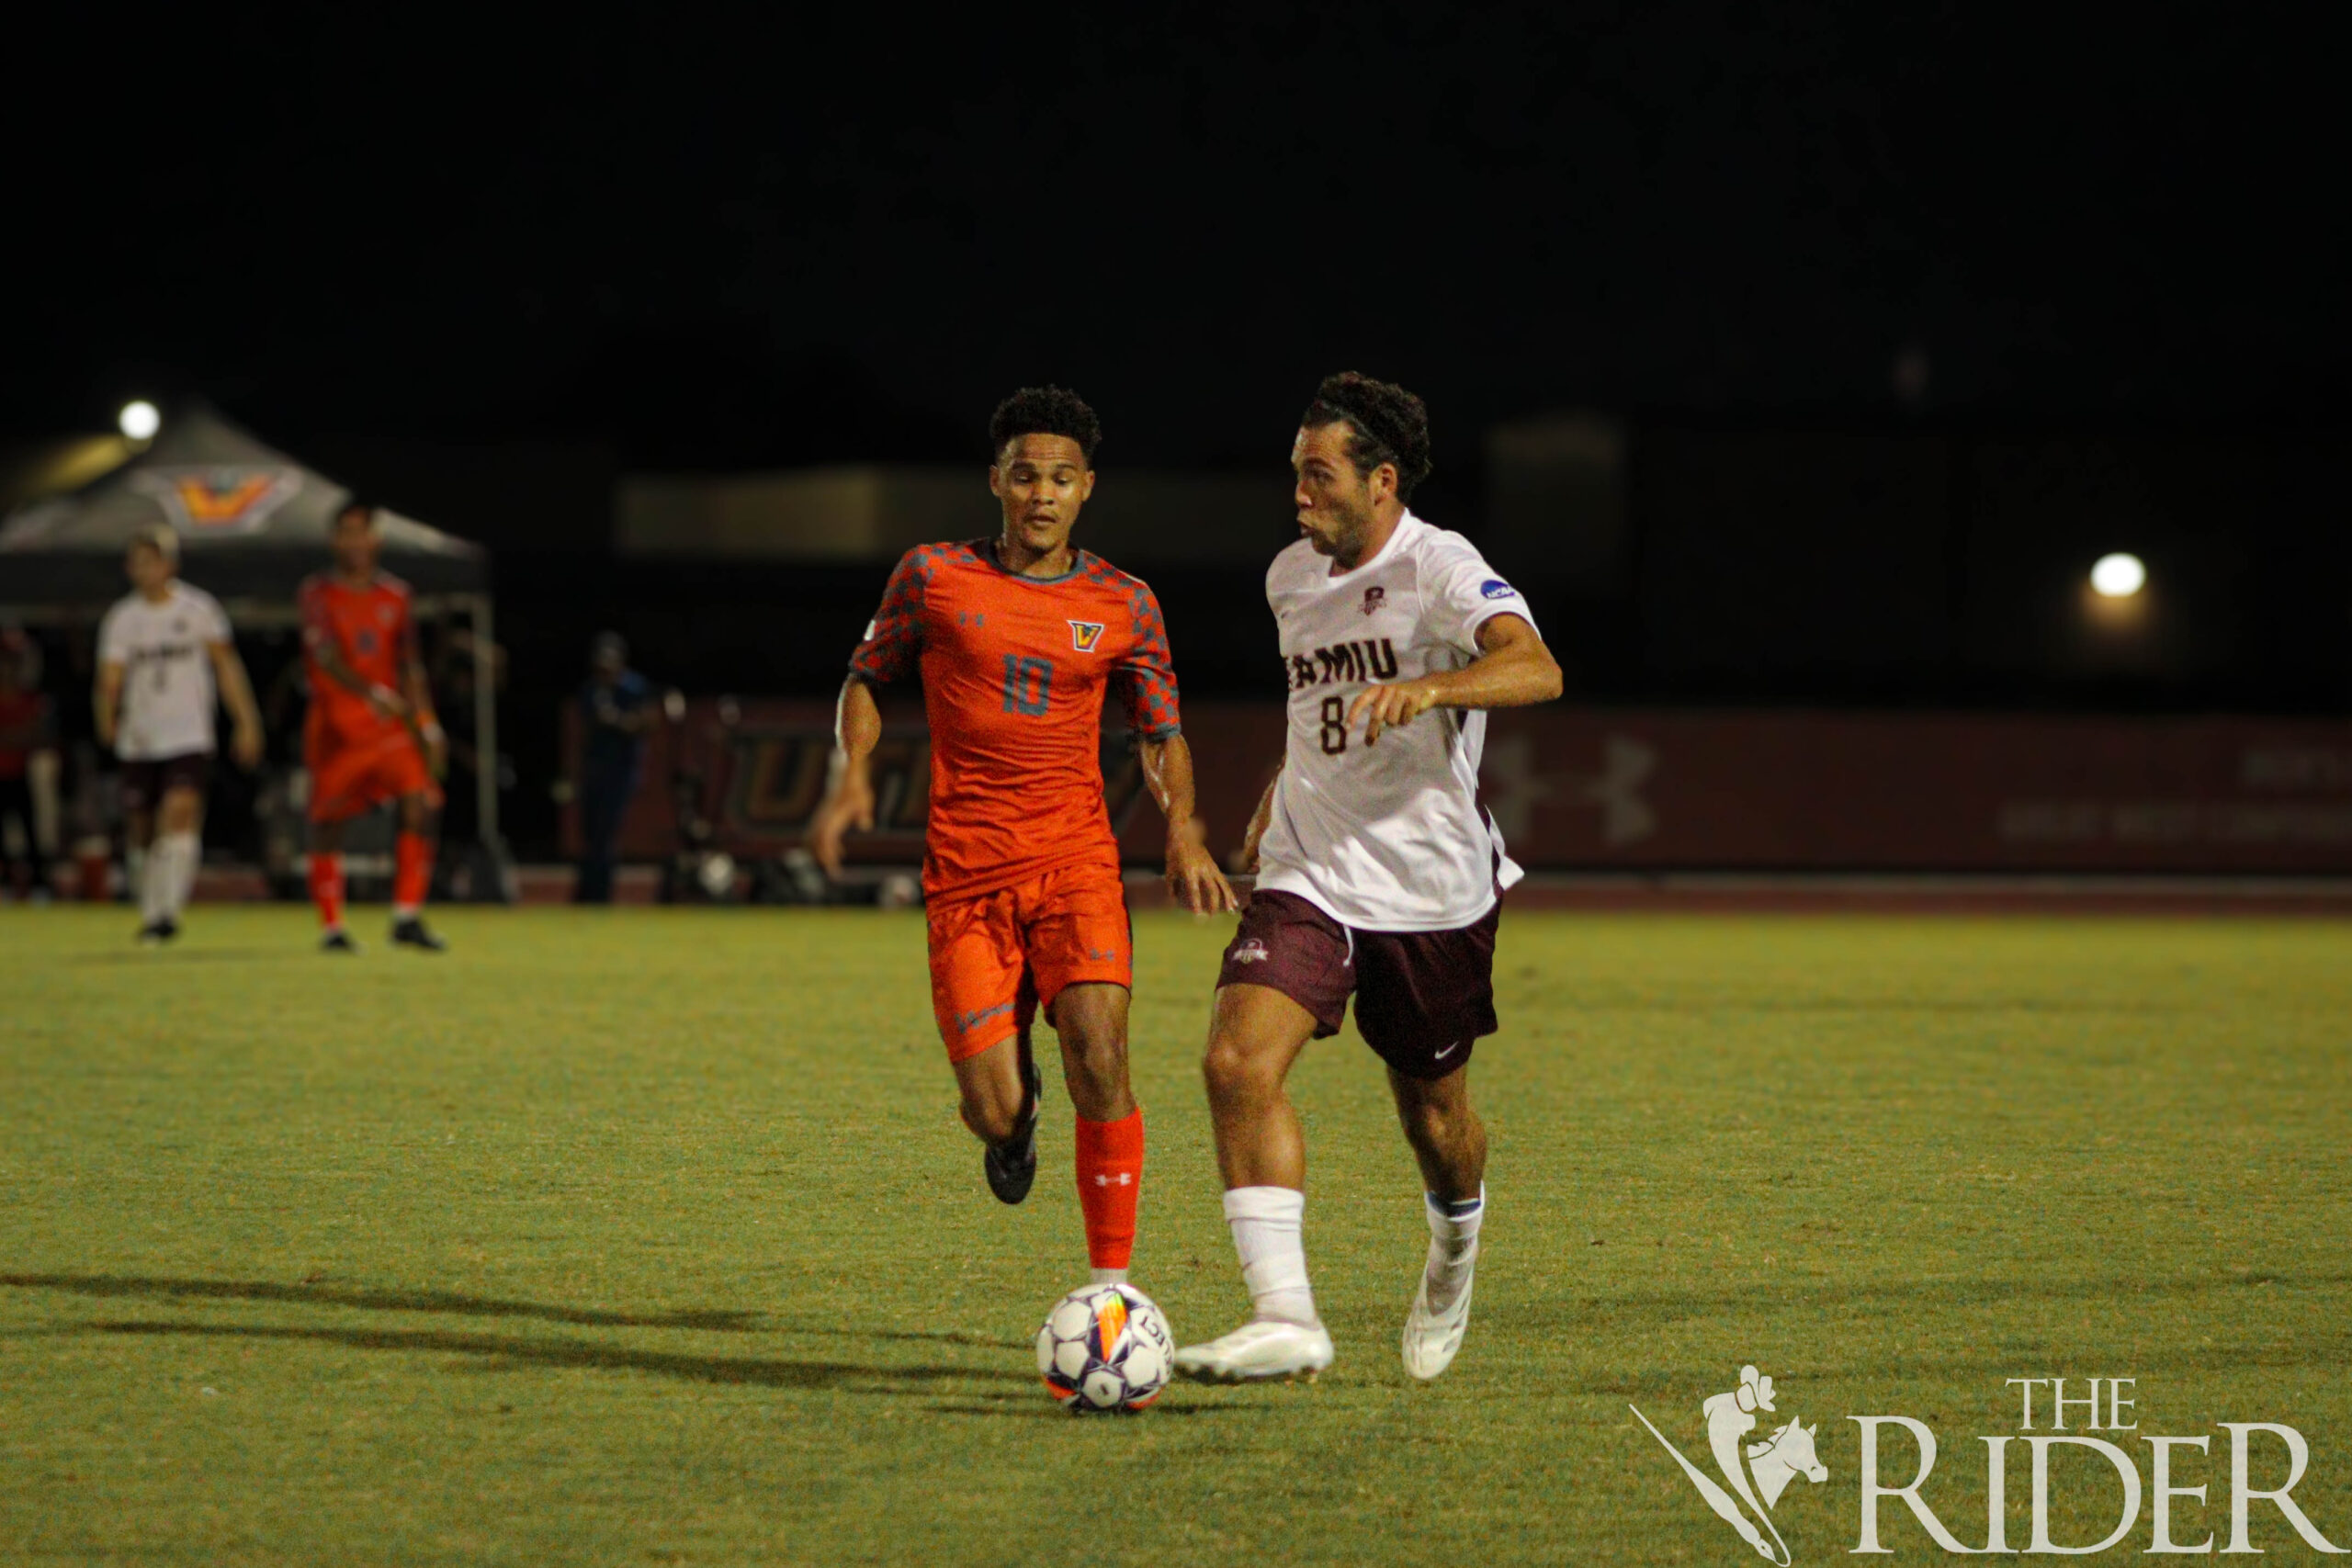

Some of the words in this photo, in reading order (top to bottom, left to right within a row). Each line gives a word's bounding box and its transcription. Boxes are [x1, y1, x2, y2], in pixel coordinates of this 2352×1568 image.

[1003, 653, 1053, 716] 10
[1283, 637, 1397, 691] AMIU
[1320, 695, 1347, 755] 8
